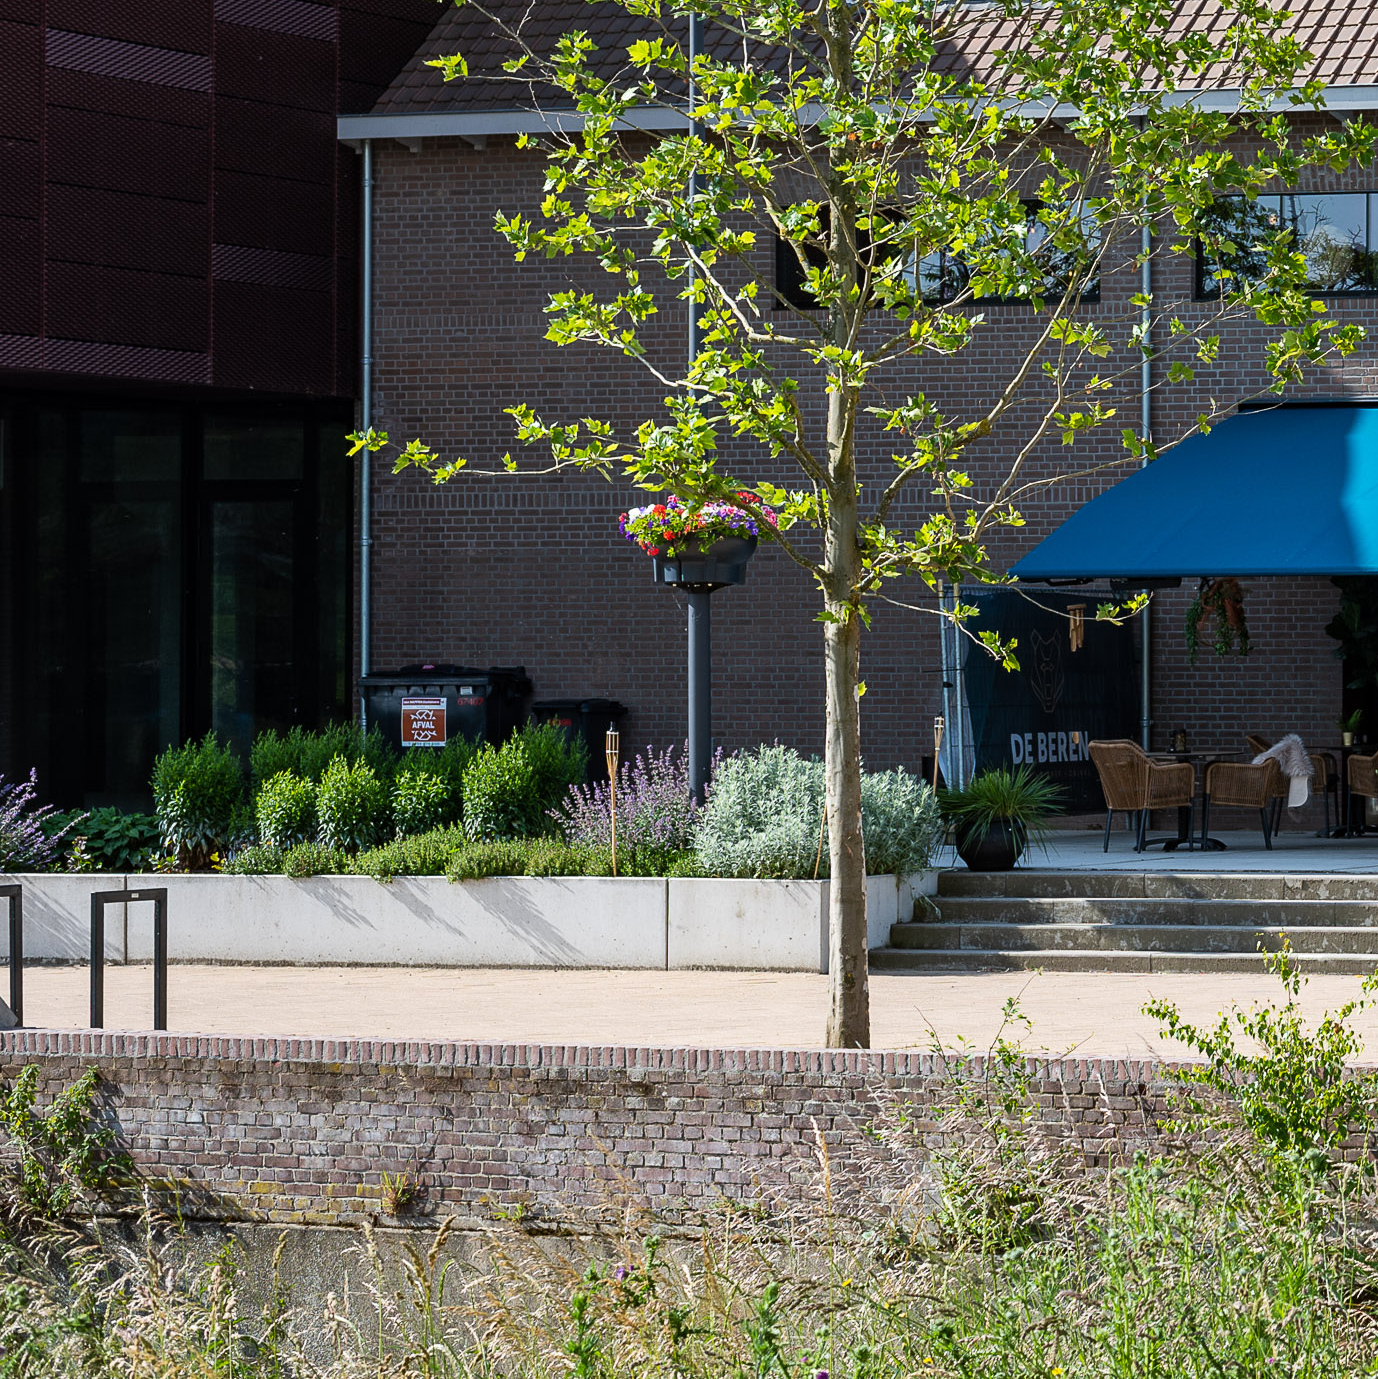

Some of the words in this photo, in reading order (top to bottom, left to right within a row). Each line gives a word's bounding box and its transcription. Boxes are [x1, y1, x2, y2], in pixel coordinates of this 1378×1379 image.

[412, 721, 435, 729] AFVAL
[1010, 733, 1034, 765] DE
[1037, 730, 1090, 763] BEREN
